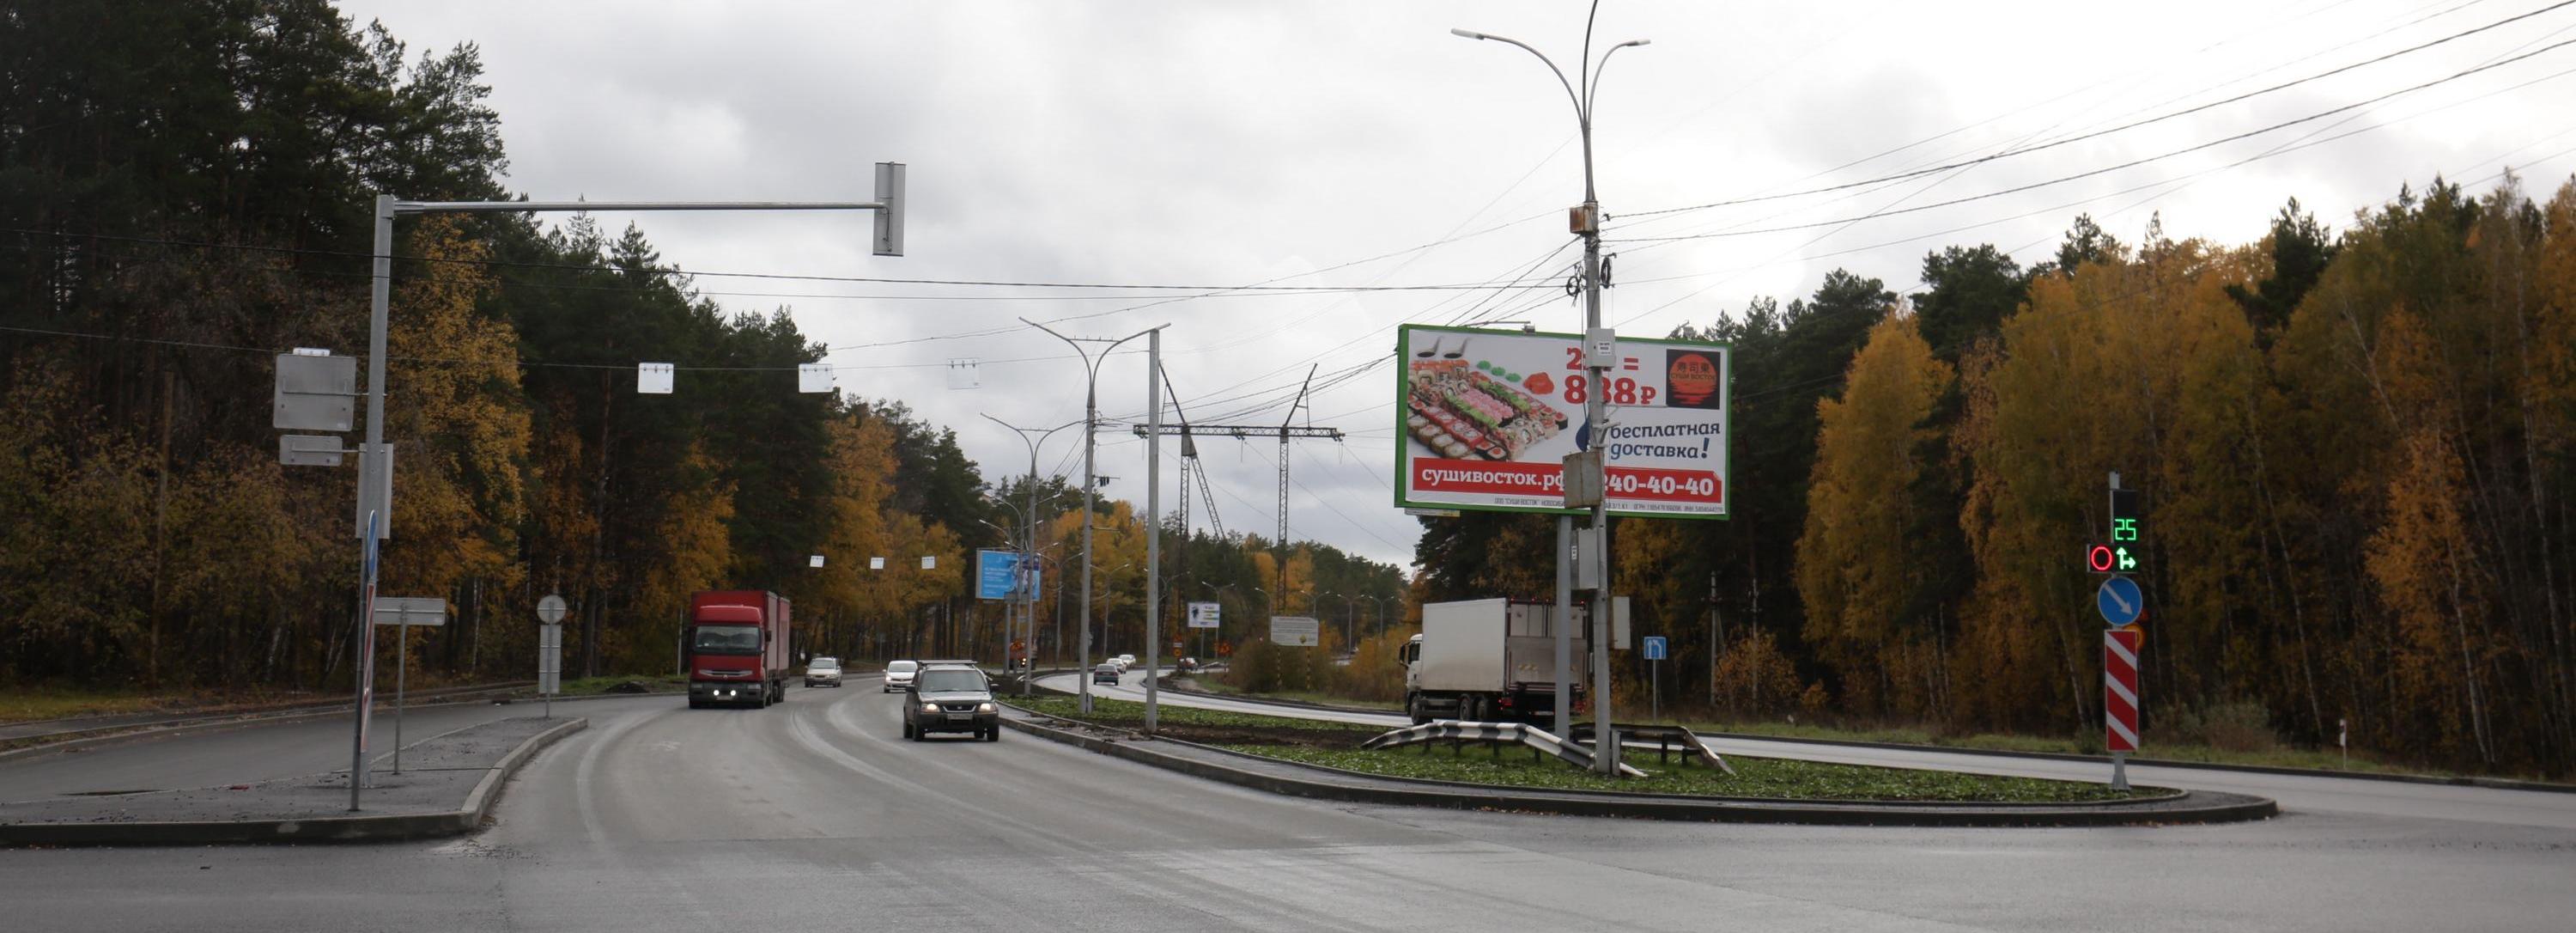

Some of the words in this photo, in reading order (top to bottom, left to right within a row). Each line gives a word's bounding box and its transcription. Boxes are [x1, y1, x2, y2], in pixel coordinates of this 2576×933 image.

[1610, 423, 1721, 439] бесплатная
[1610, 437, 1710, 460] доставка!
[2115, 519, 2136, 540] 25
